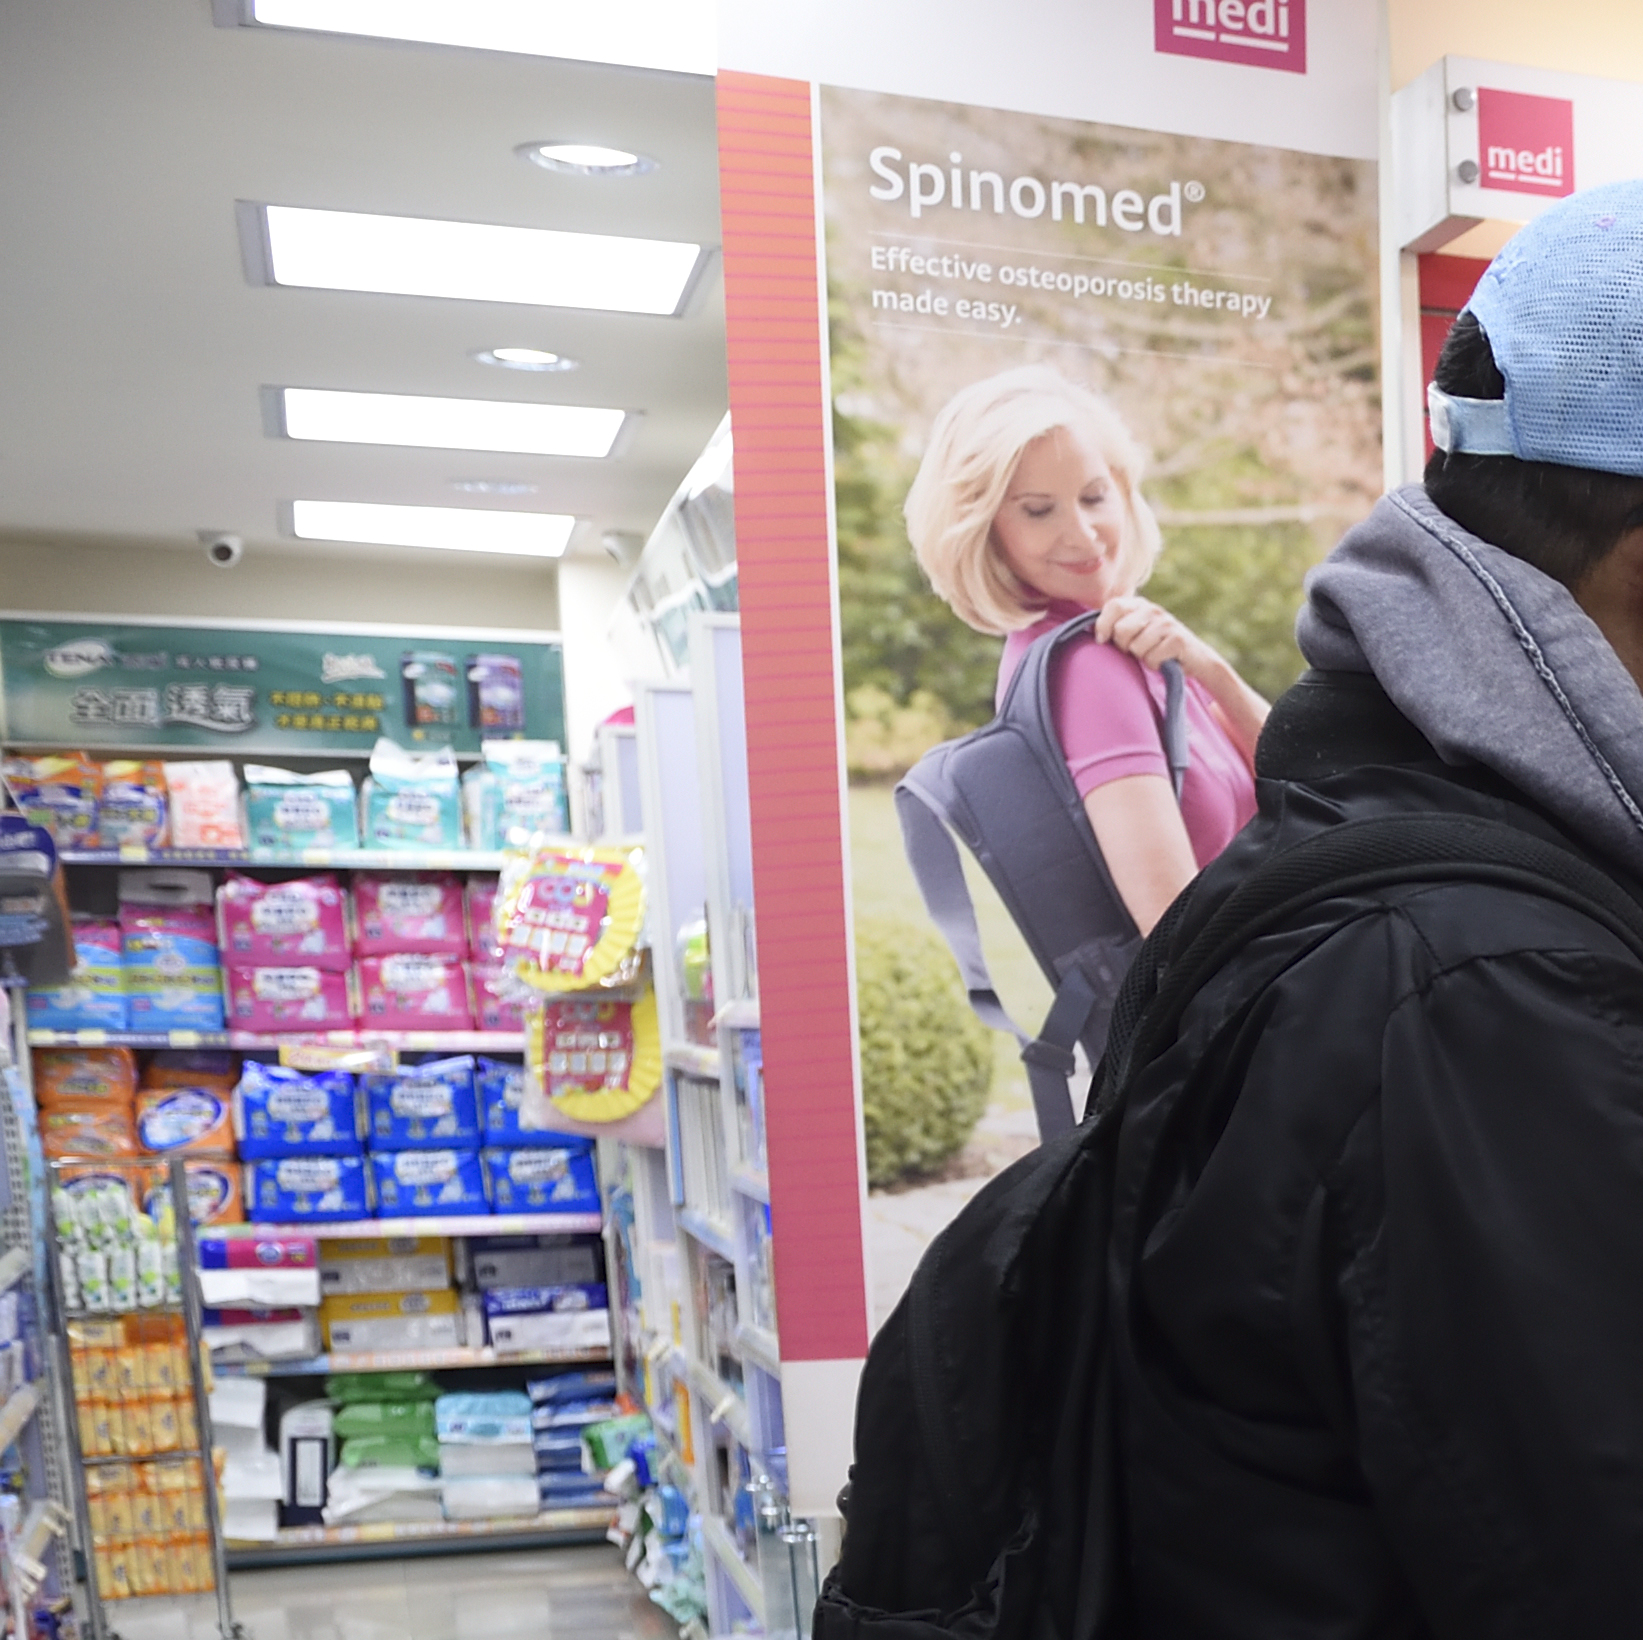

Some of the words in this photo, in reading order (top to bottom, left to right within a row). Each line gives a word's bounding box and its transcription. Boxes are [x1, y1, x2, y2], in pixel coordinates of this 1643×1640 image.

[1172, 0, 1290, 37] medi
[1487, 144, 1564, 178] medi
[870, 246, 992, 282] Effective
[998, 262, 1166, 303] osteoporosis
[1170, 281, 1272, 320] therapy
[871, 289, 949, 316] made
[955, 298, 1022, 329] easy.
